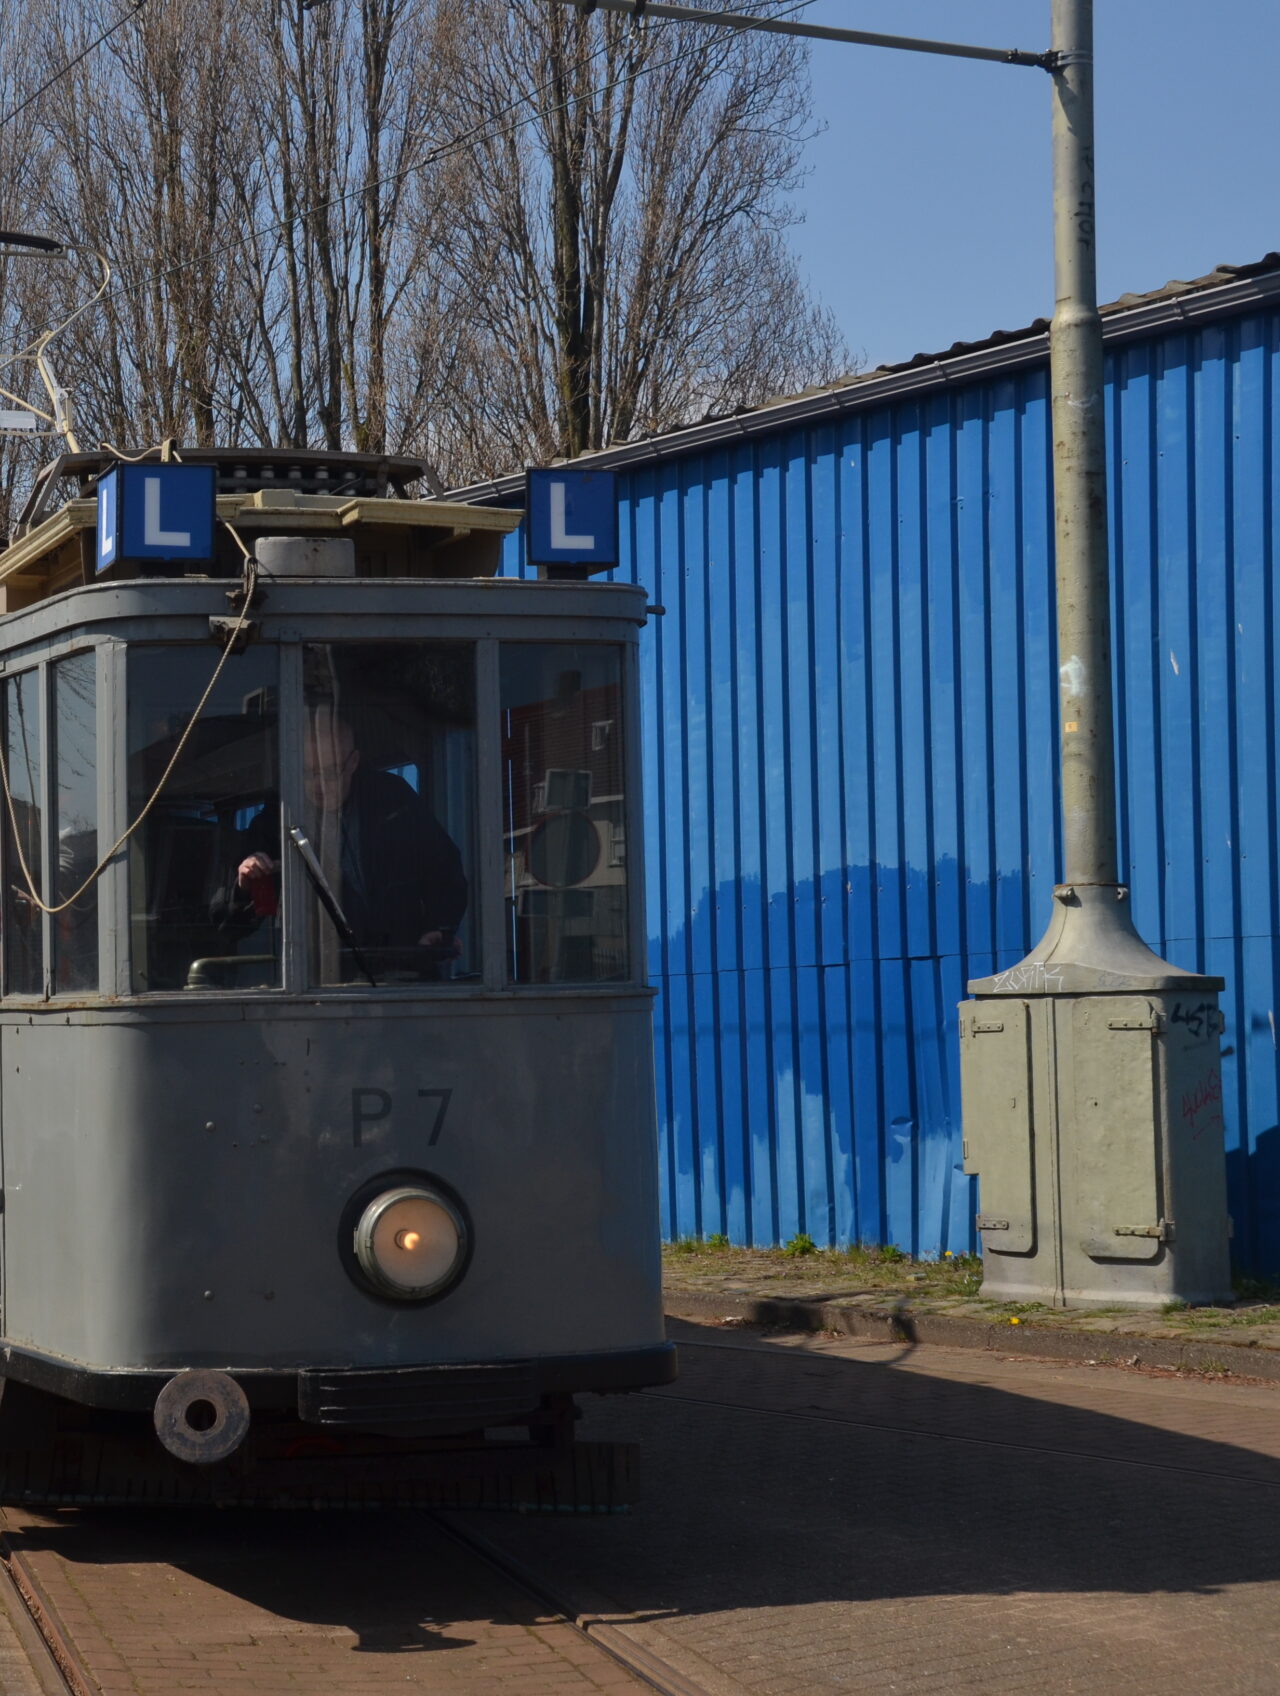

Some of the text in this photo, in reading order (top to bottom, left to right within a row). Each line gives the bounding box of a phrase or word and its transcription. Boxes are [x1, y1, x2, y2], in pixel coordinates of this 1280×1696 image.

[100, 488, 114, 557] L
[143, 476, 191, 548] L
[549, 481, 595, 550] L
